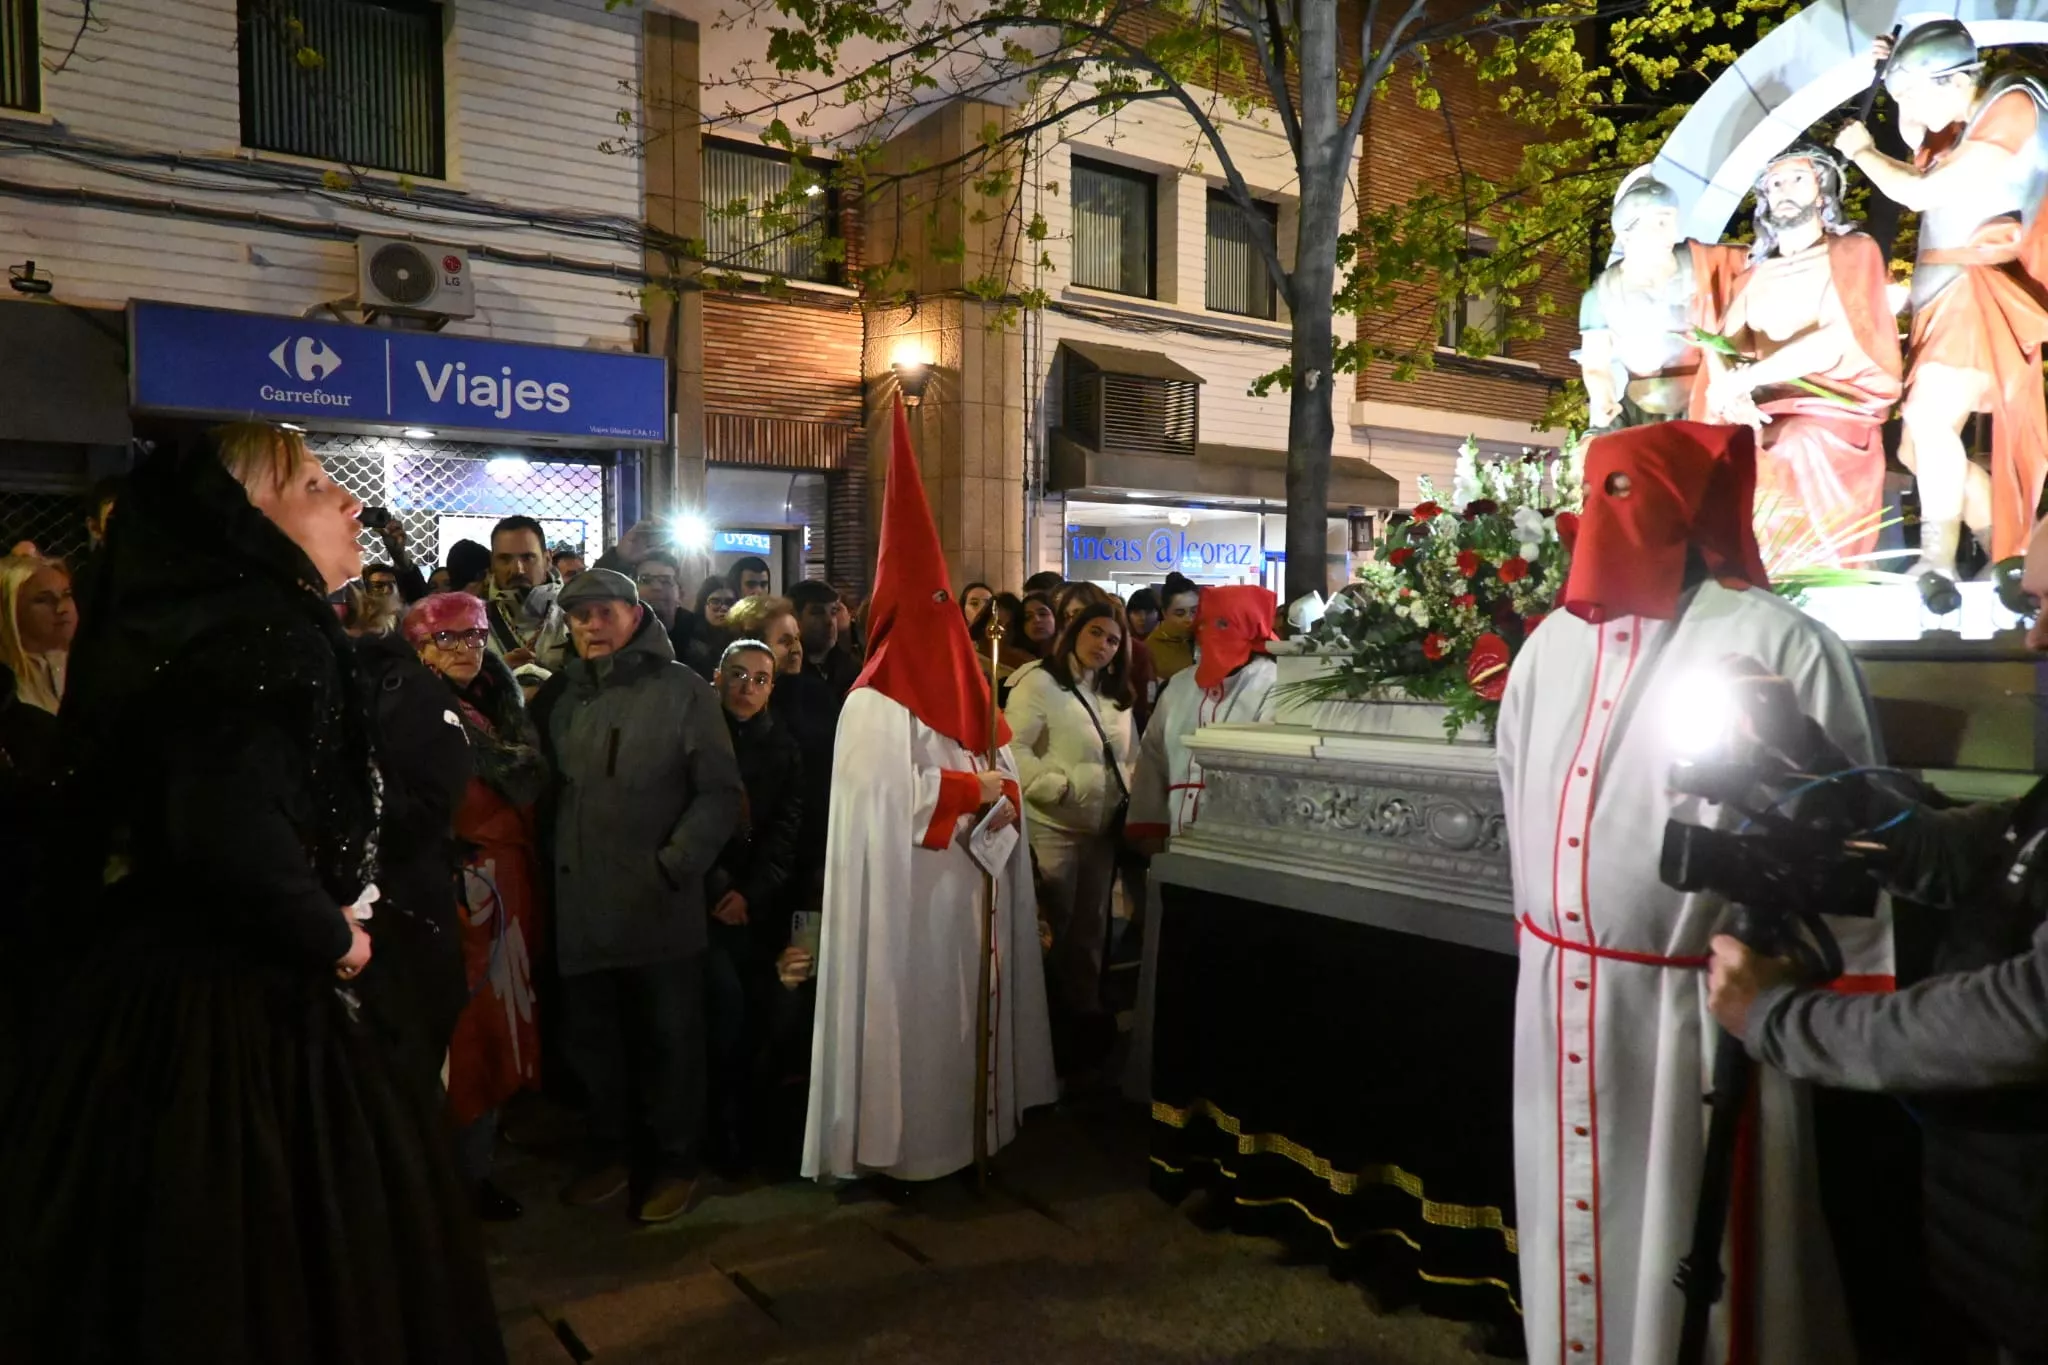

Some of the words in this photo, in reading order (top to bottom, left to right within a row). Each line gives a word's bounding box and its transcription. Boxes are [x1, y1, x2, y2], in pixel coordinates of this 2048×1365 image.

[445, 275, 461, 287] LG
[260, 385, 352, 406] Carrefour
[415, 360, 570, 419] Viajes
